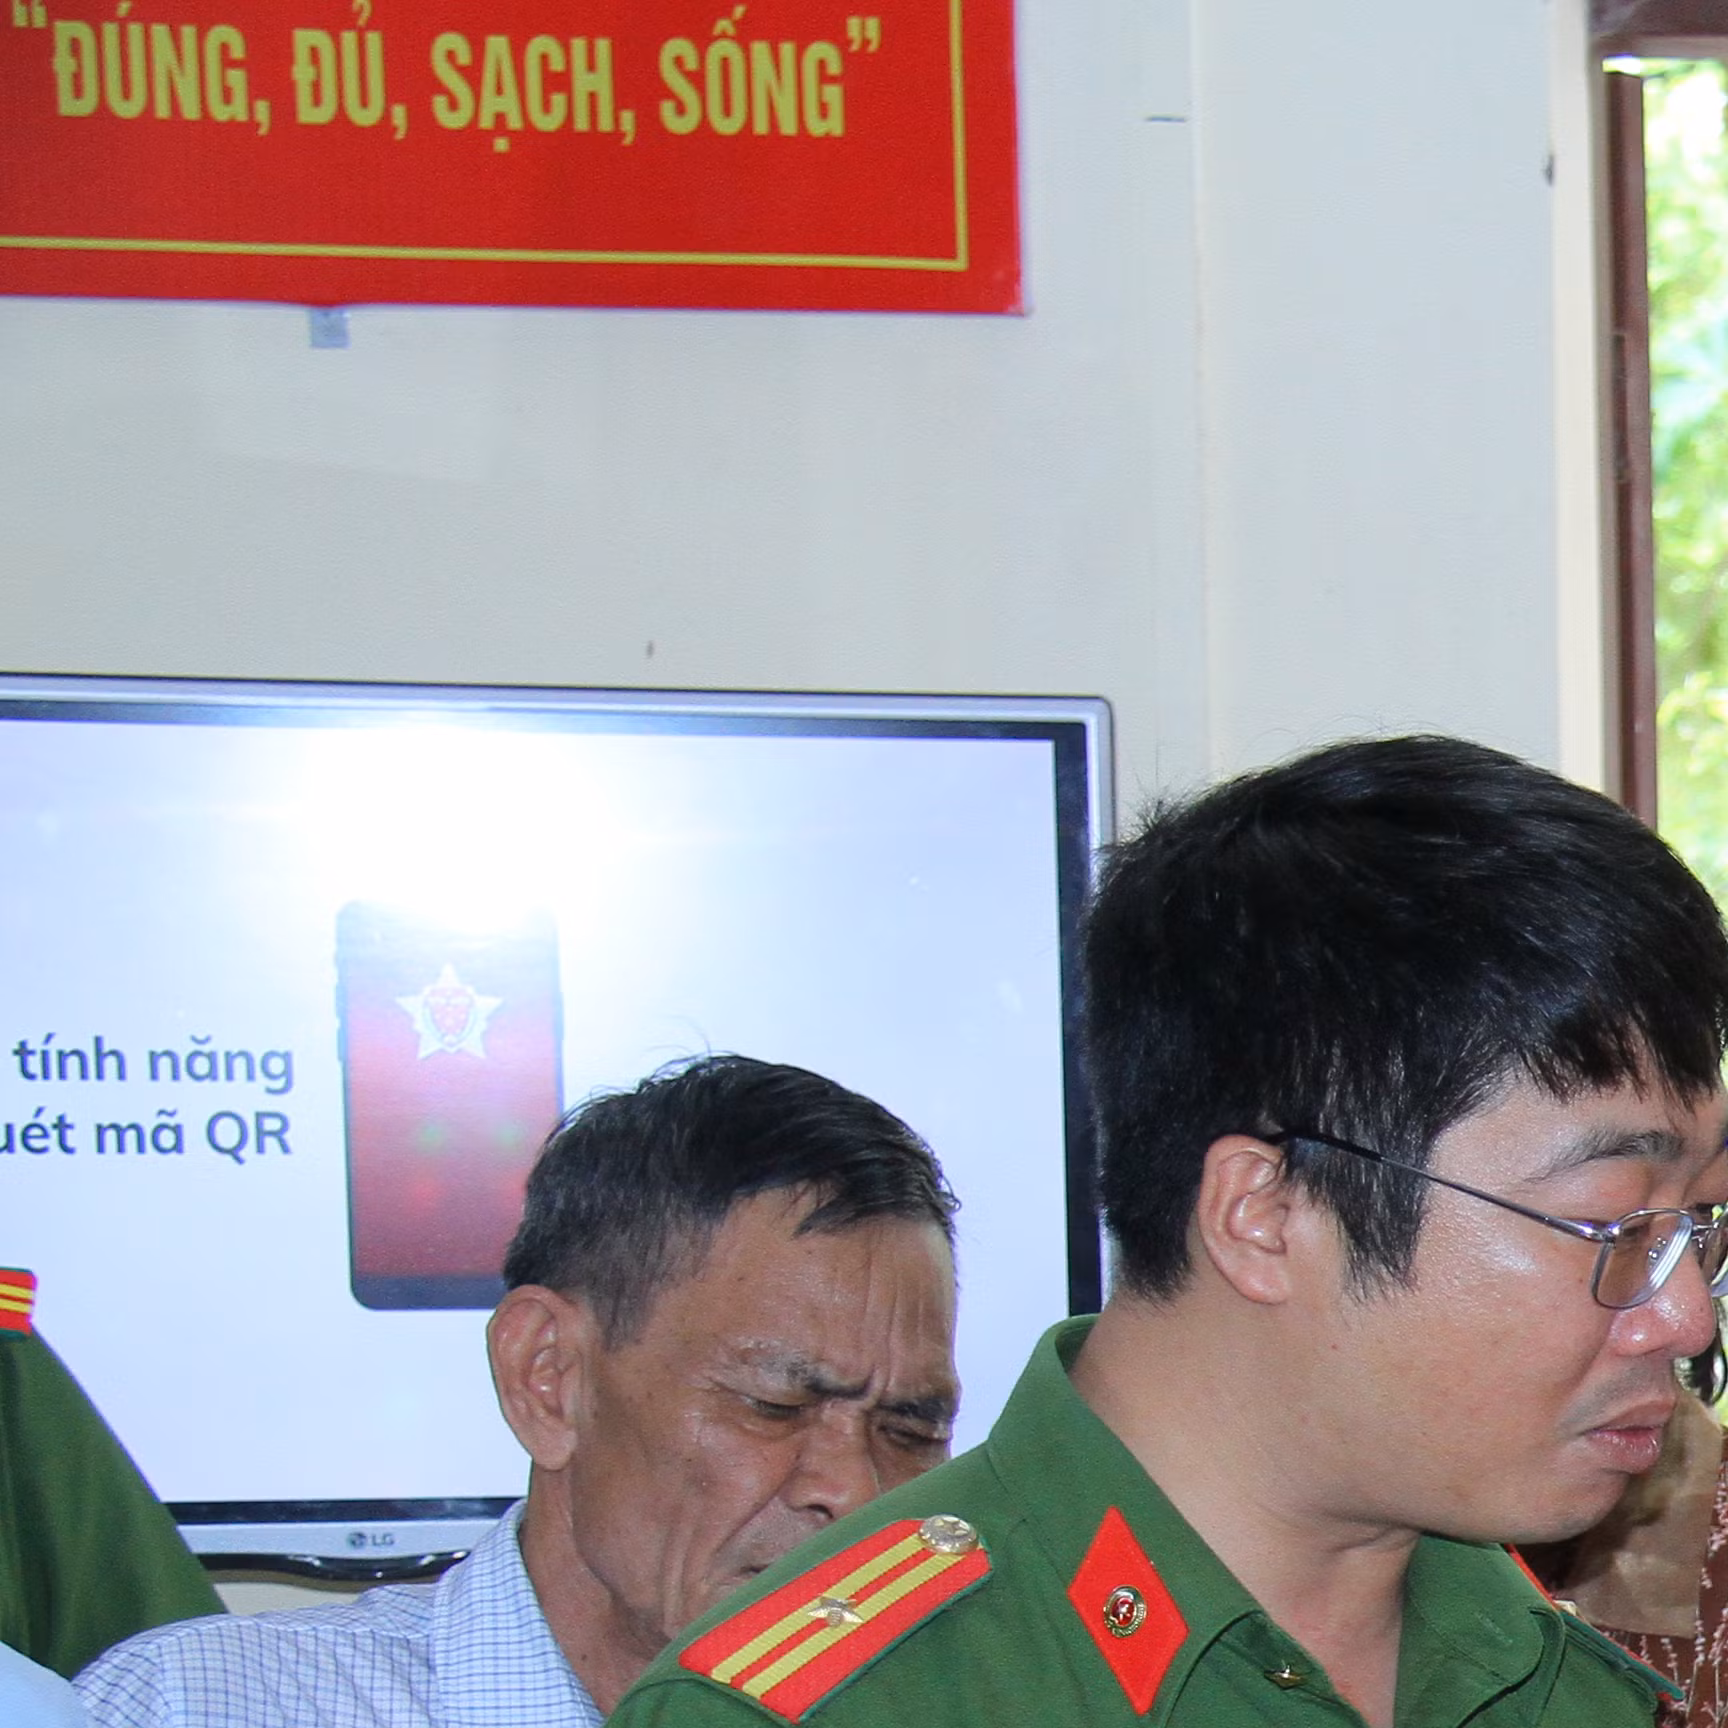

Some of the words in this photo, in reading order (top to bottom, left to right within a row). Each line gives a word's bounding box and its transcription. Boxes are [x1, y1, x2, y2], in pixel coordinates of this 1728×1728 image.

[292, 0, 408, 139] ĐỦ,
[431, 31, 636, 152] SẠCH,
[660, 4, 882, 137] SỐNG”
[12, 1032, 126, 1081] tính
[148, 1035, 293, 1095] năng
[96, 1108, 185, 1155] mã
[206, 1110, 292, 1165] QR
[371, 1533, 395, 1547] LG
